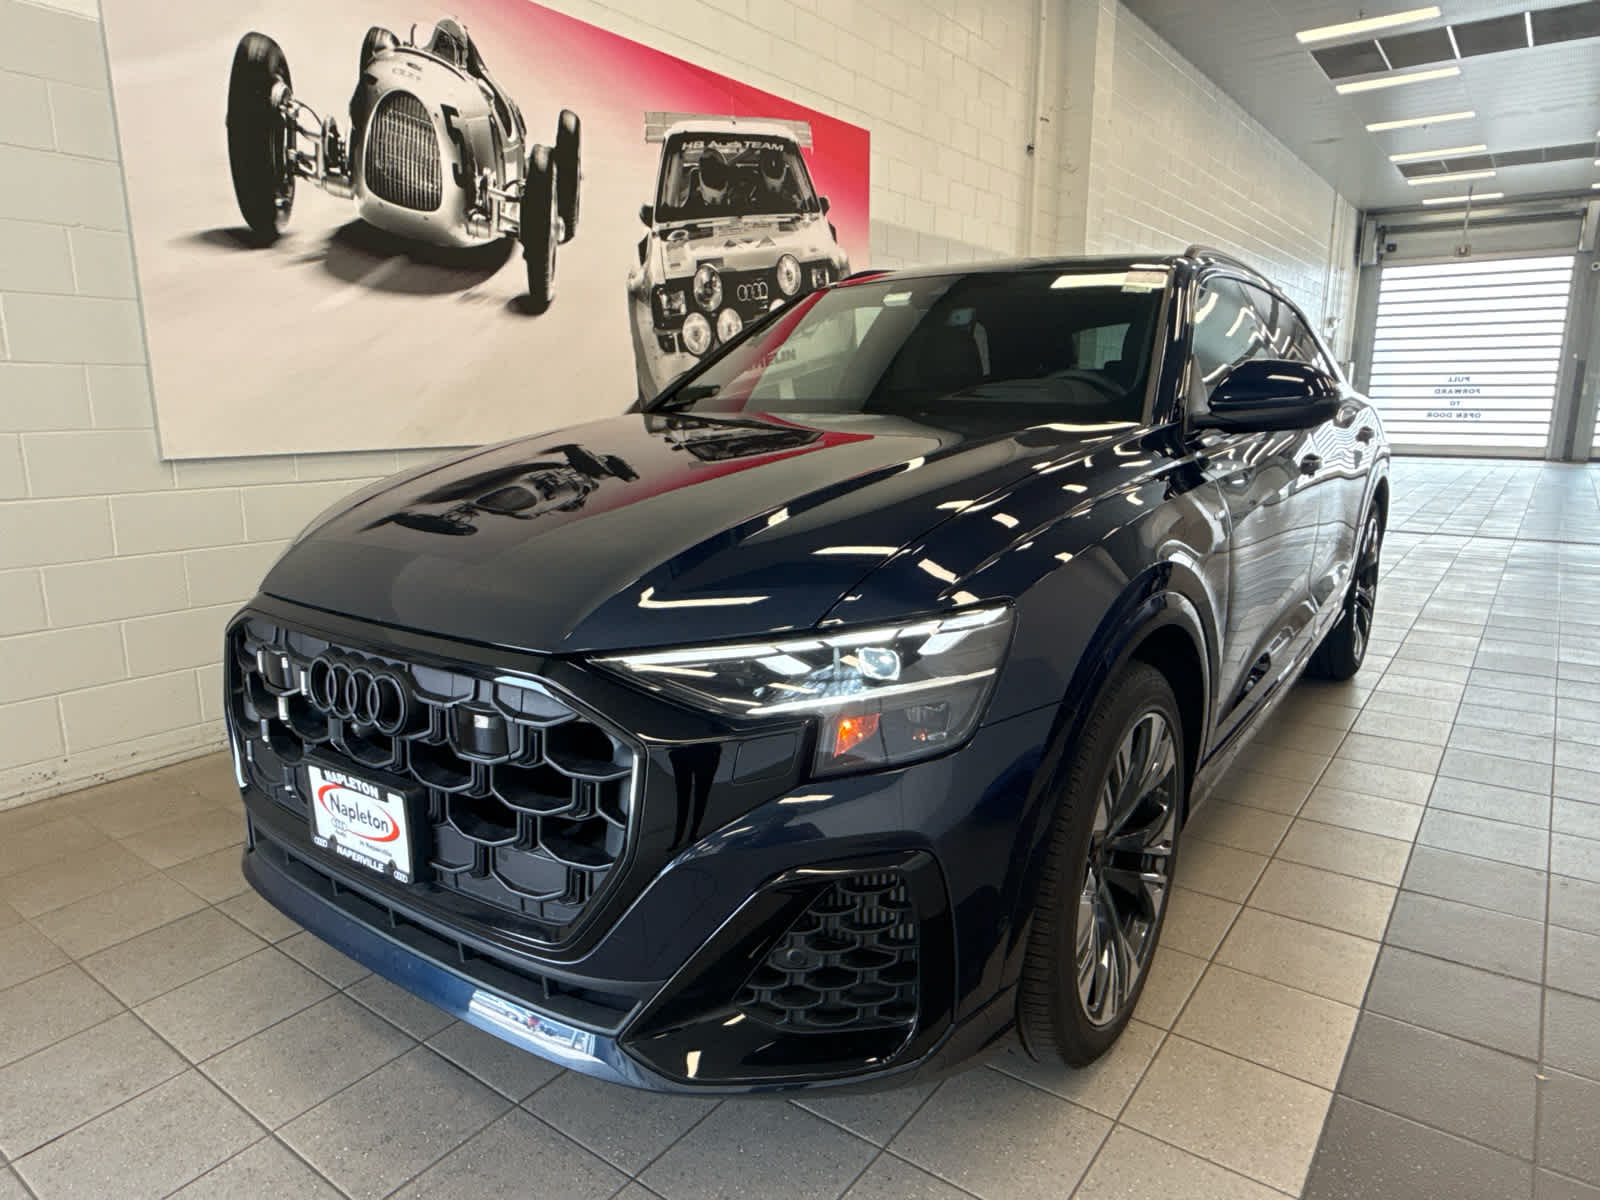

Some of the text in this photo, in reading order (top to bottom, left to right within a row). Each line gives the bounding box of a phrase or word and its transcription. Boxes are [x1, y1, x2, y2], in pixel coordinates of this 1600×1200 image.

[744, 141, 784, 152] TEAM
[323, 769, 379, 800] NAPLETON
[329, 792, 389, 834] Napleton
[336, 844, 385, 873] NAPERVILLE
